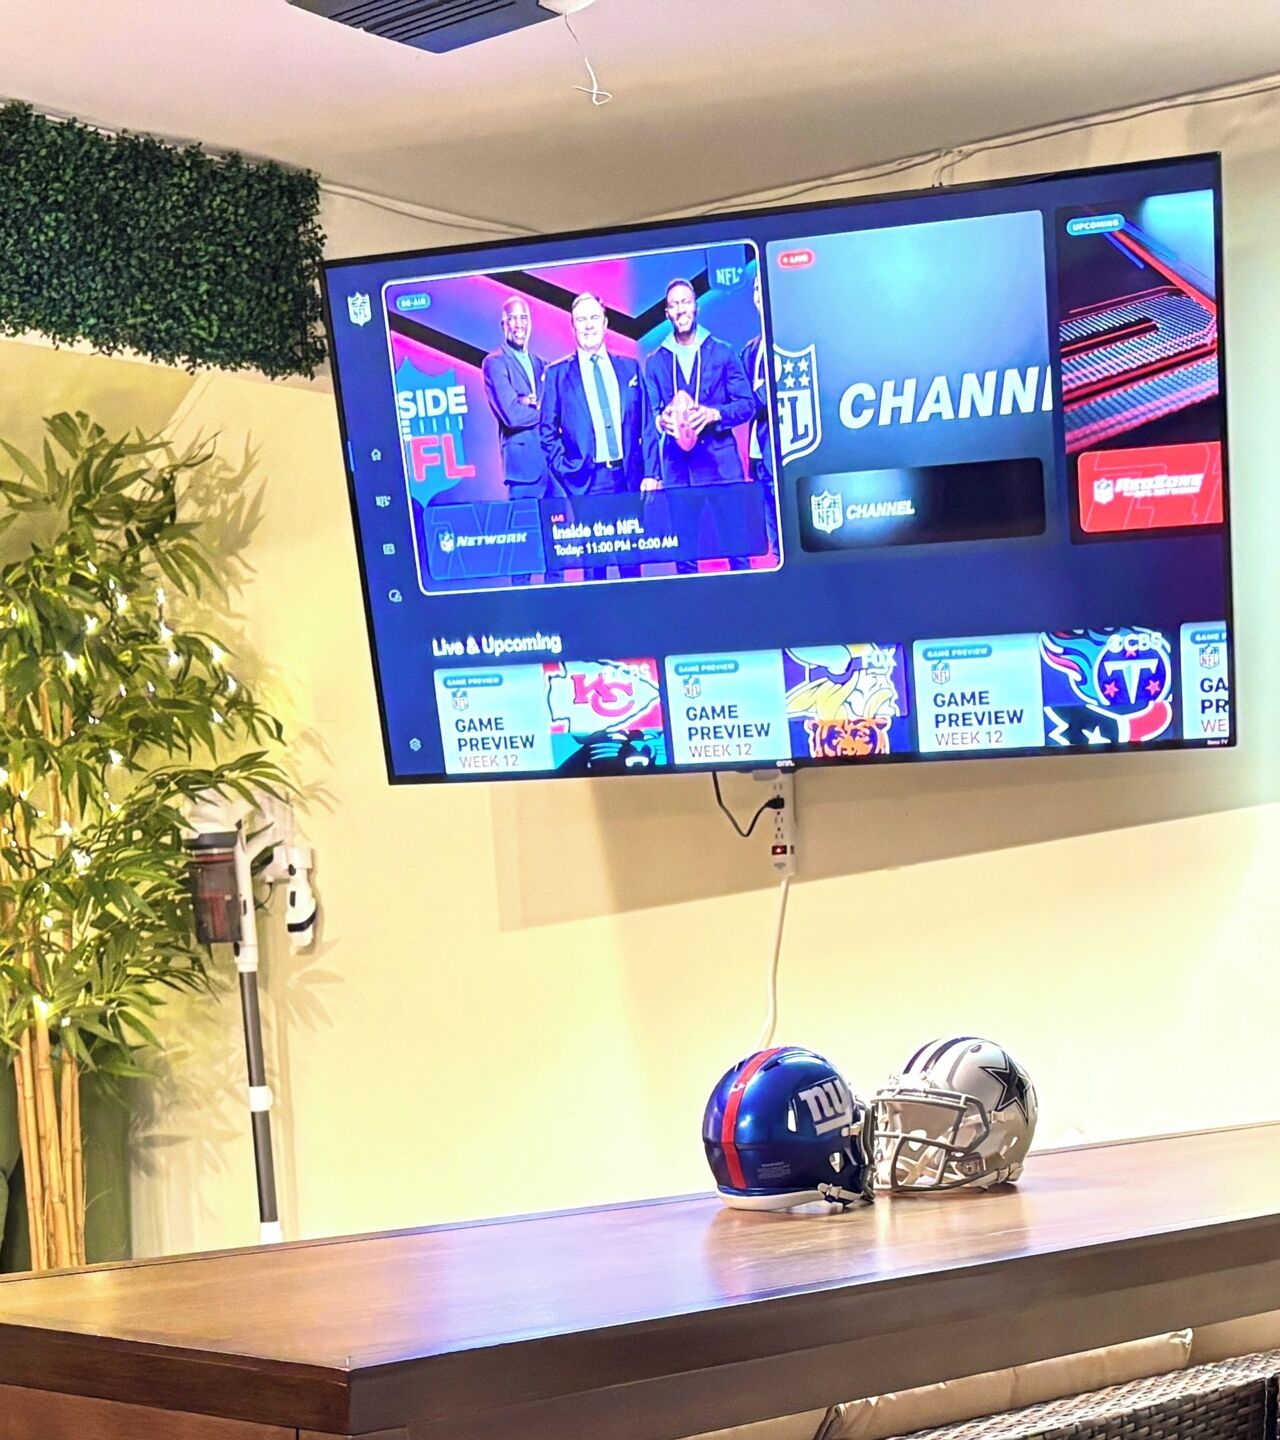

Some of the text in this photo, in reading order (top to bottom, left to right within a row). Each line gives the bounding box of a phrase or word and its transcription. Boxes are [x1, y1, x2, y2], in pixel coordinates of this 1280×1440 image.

[1071, 218, 1120, 232] UPCOMING
[397, 384, 469, 419] SIDE
[845, 499, 916, 521] CHANNEL
[552, 516, 645, 540] Inside the NFL
[456, 531, 528, 548] NETWORK
[585, 540, 613, 554] 11:00
[613, 537, 632, 551] PM
[661, 534, 679, 548] AM
[431, 631, 563, 657] Live & Upcoming
[861, 647, 898, 669] FOX
[933, 690, 991, 708] GAME
[685, 704, 739, 722] GAME
[935, 709, 1025, 729] PREVIEW
[455, 716, 505, 733] GAME
[688, 723, 771, 742] PREVIEW
[457, 734, 535, 752] PREVIEW
[935, 729, 1003, 747] WEEK 12
[689, 743, 752, 759] WEEK 12
[459, 753, 519, 769] WEEK 12
